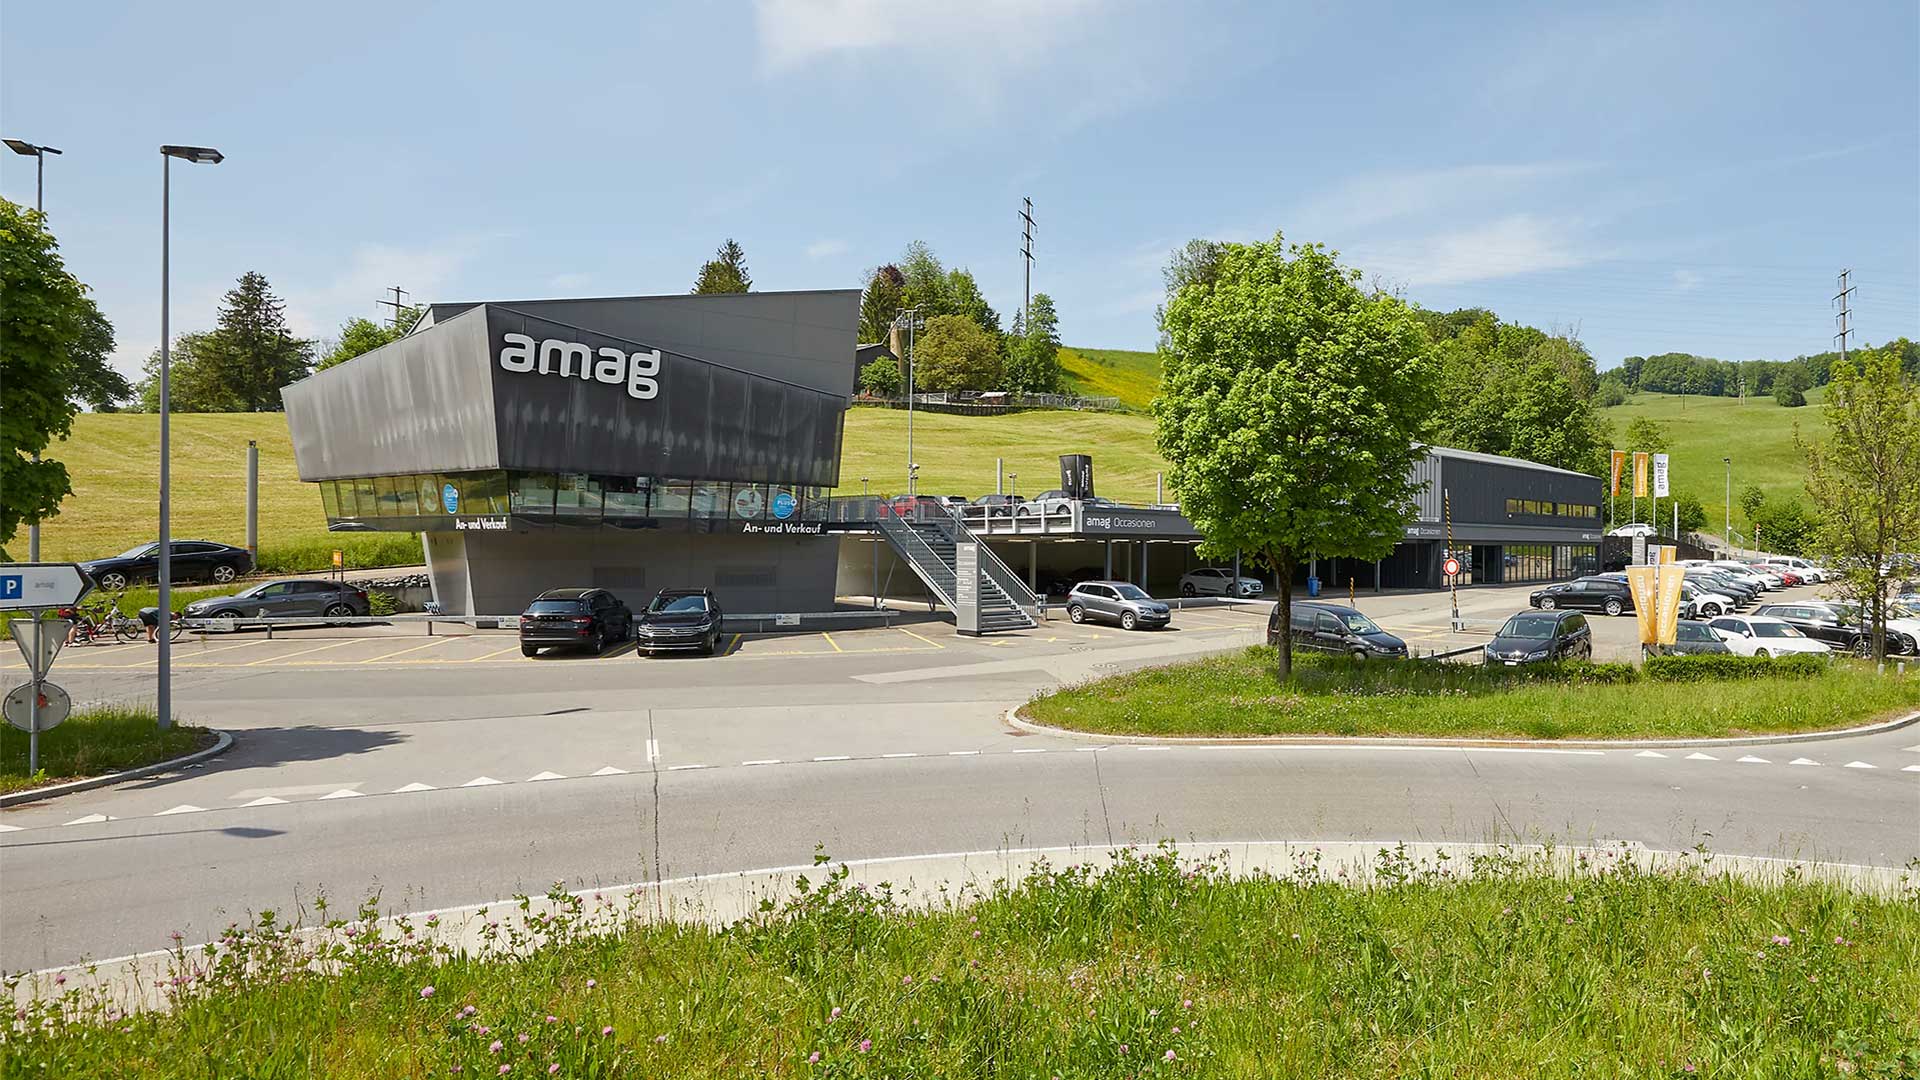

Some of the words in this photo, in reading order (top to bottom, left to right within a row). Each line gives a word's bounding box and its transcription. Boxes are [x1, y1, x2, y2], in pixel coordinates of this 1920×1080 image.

[500, 333, 661, 400] amag
[1657, 462, 1666, 490] amag
[455, 517, 467, 530] An-
[467, 517, 480, 530] und
[480, 516, 507, 530] Verkauf
[742, 522, 762, 533] An-
[764, 523, 783, 533] und
[784, 523, 821, 534] Verkauf
[1086, 517, 1111, 529] amag
[1113, 517, 1156, 528] Occasionen
[6, 580, 17, 594] P
